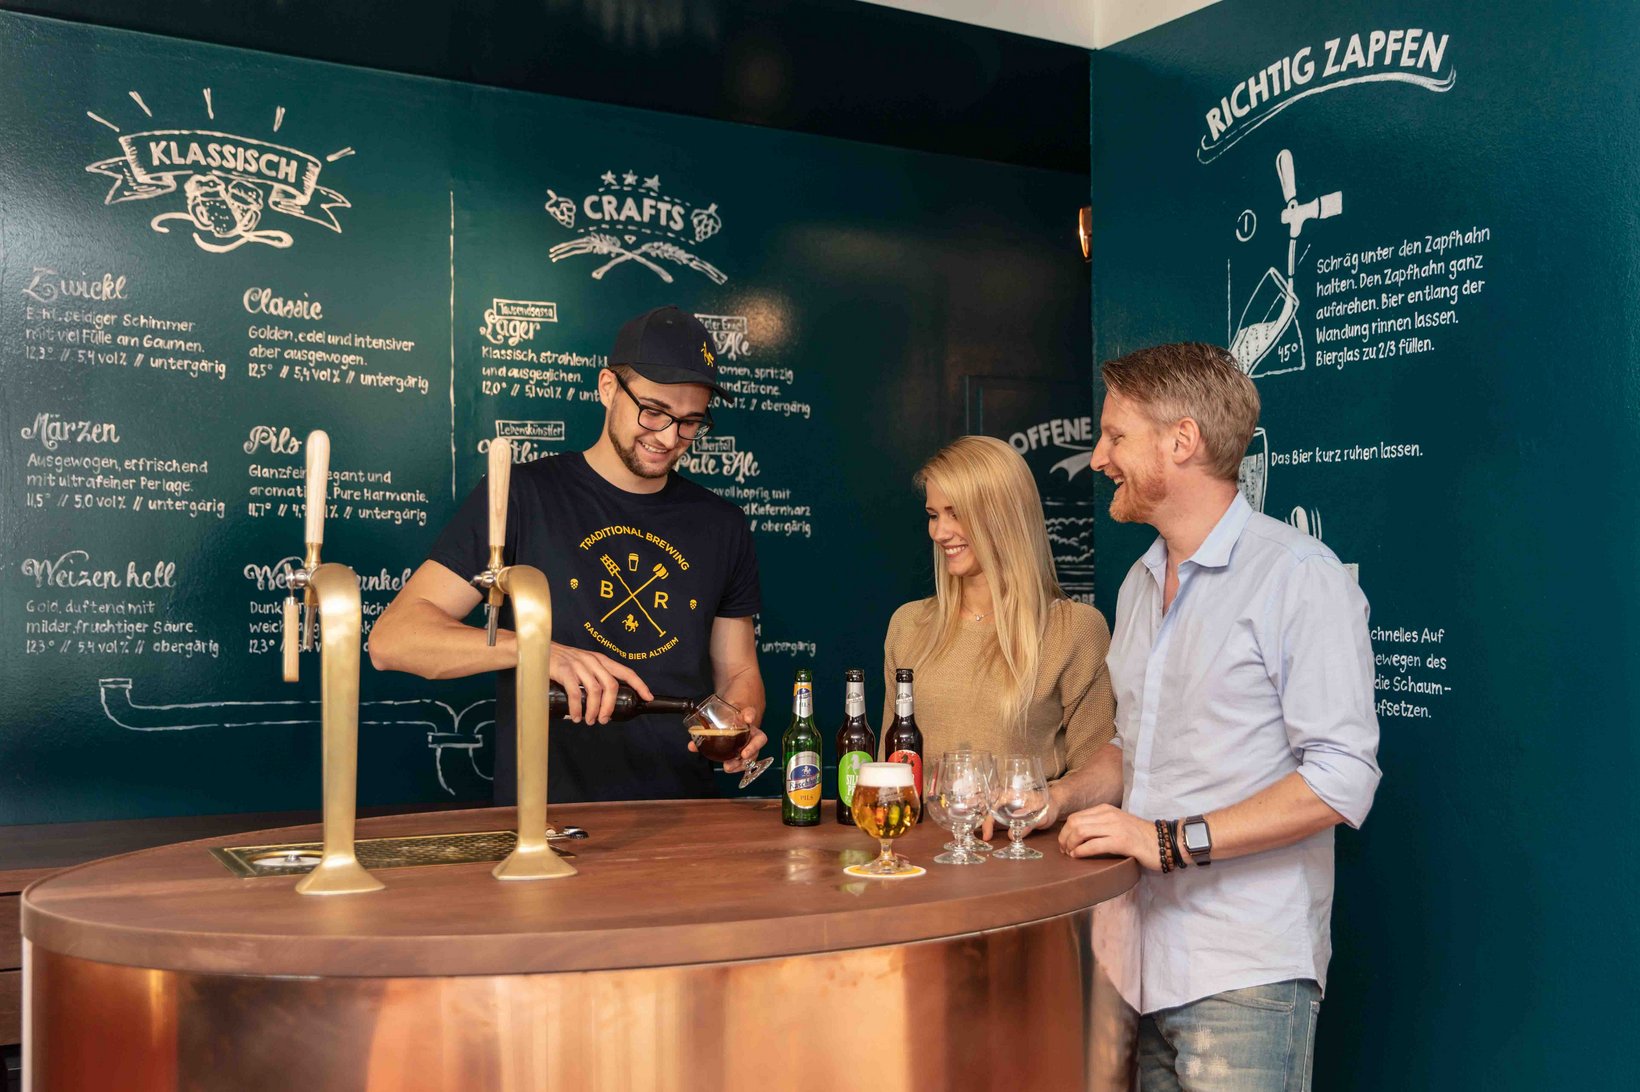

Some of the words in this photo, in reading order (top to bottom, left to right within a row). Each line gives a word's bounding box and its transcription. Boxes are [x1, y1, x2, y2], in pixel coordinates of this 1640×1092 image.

[1205, 46, 1315, 141] RICHTIG
[1322, 28, 1449, 78] ZAPFEN
[150, 141, 297, 183] KLASSISCH
[584, 195, 685, 231] CRAFTS
[1361, 245, 1395, 262] unter
[1398, 240, 1422, 257] den
[1425, 226, 1491, 256] Zapfhahn
[22, 266, 128, 301] Zwickl
[1316, 278, 1358, 298] halten.
[1360, 271, 1382, 288] Den
[1384, 259, 1445, 287] Zapfhahn
[1449, 254, 1484, 280] ganz
[243, 287, 323, 320] Classic
[1316, 299, 1380, 320] aufdrehen.
[1381, 293, 1404, 310] Bier
[1407, 284, 1459, 305] entlang
[1462, 278, 1486, 295] der
[64, 309, 117, 330] seidiger
[123, 314, 196, 332] Schimmer
[480, 309, 541, 346] Lager
[1316, 323, 1370, 345] Wandung
[1371, 318, 1412, 335] rinnen
[1414, 309, 1459, 330] lassen.
[57, 328, 79, 343] viel
[82, 328, 112, 345] Fülle
[117, 334, 139, 347] am
[143, 334, 205, 353] Gaumen.
[328, 333, 352, 346] und
[355, 334, 415, 352] intensiver
[249, 345, 281, 359] aber
[284, 350, 368, 370] ausgewogen.
[540, 351, 596, 368] strahlend
[1277, 343, 1299, 364] 45°
[1316, 346, 1360, 371] Bierglas
[1362, 345, 1377, 361] zu
[1378, 341, 1396, 361] 2/3
[1398, 337, 1435, 355] füllen.
[150, 357, 226, 380] untergärig
[482, 366, 507, 378] und
[508, 369, 584, 386] ausgeglichen.
[718, 365, 752, 379] omen,
[754, 366, 794, 385] spritzig
[360, 372, 429, 395] untergärig
[761, 399, 811, 419] obergärig
[21, 412, 120, 450] Märzen
[500, 422, 562, 436] Lebenskünstler
[1008, 417, 1092, 455] OFFENE
[243, 425, 302, 455] Pils
[27, 453, 121, 474] Ausgewogen,
[124, 457, 208, 474] erfrischend
[1271, 451, 1290, 467] Das
[1292, 450, 1313, 466] Bier
[1315, 447, 1341, 463] kurz
[1343, 445, 1378, 461] ruhen
[1380, 441, 1424, 459] lassen.
[368, 470, 392, 484] und
[672, 452, 720, 475] Pale
[722, 451, 760, 484] Ale
[26, 473, 55, 486] mit
[59, 474, 135, 491] ultrafeiner
[334, 487, 361, 501] Pure
[364, 488, 429, 503] Harmonie.
[772, 488, 791, 500] mit
[148, 498, 225, 519] untergärig
[358, 507, 427, 526] untergärig
[751, 503, 811, 516] Kiefernharz
[761, 520, 811, 538] obergärig
[580, 525, 644, 551] TRADITIONAL
[645, 532, 690, 571] BREWING
[21, 550, 121, 589] Weizen
[126, 560, 177, 589] hell
[600, 580, 614, 599] B
[654, 591, 669, 609] R
[65, 601, 125, 615] duftend
[128, 601, 155, 615] mit
[75, 621, 149, 640] fruchtiger
[153, 620, 198, 635] Säure.
[584, 621, 627, 659] RASCHHOFER
[628, 652, 647, 660] BIER
[649, 636, 679, 658] ALTHEIM
[1370, 626, 1419, 643] chnelles
[1420, 627, 1445, 644] Auf
[152, 640, 220, 658] obergärig
[762, 640, 816, 657] untergärig
[1375, 654, 1421, 673] ewegen
[1426, 653, 1447, 670] des
[1392, 676, 1452, 695] Schaum-
[1374, 699, 1432, 718] ufsetzen.
